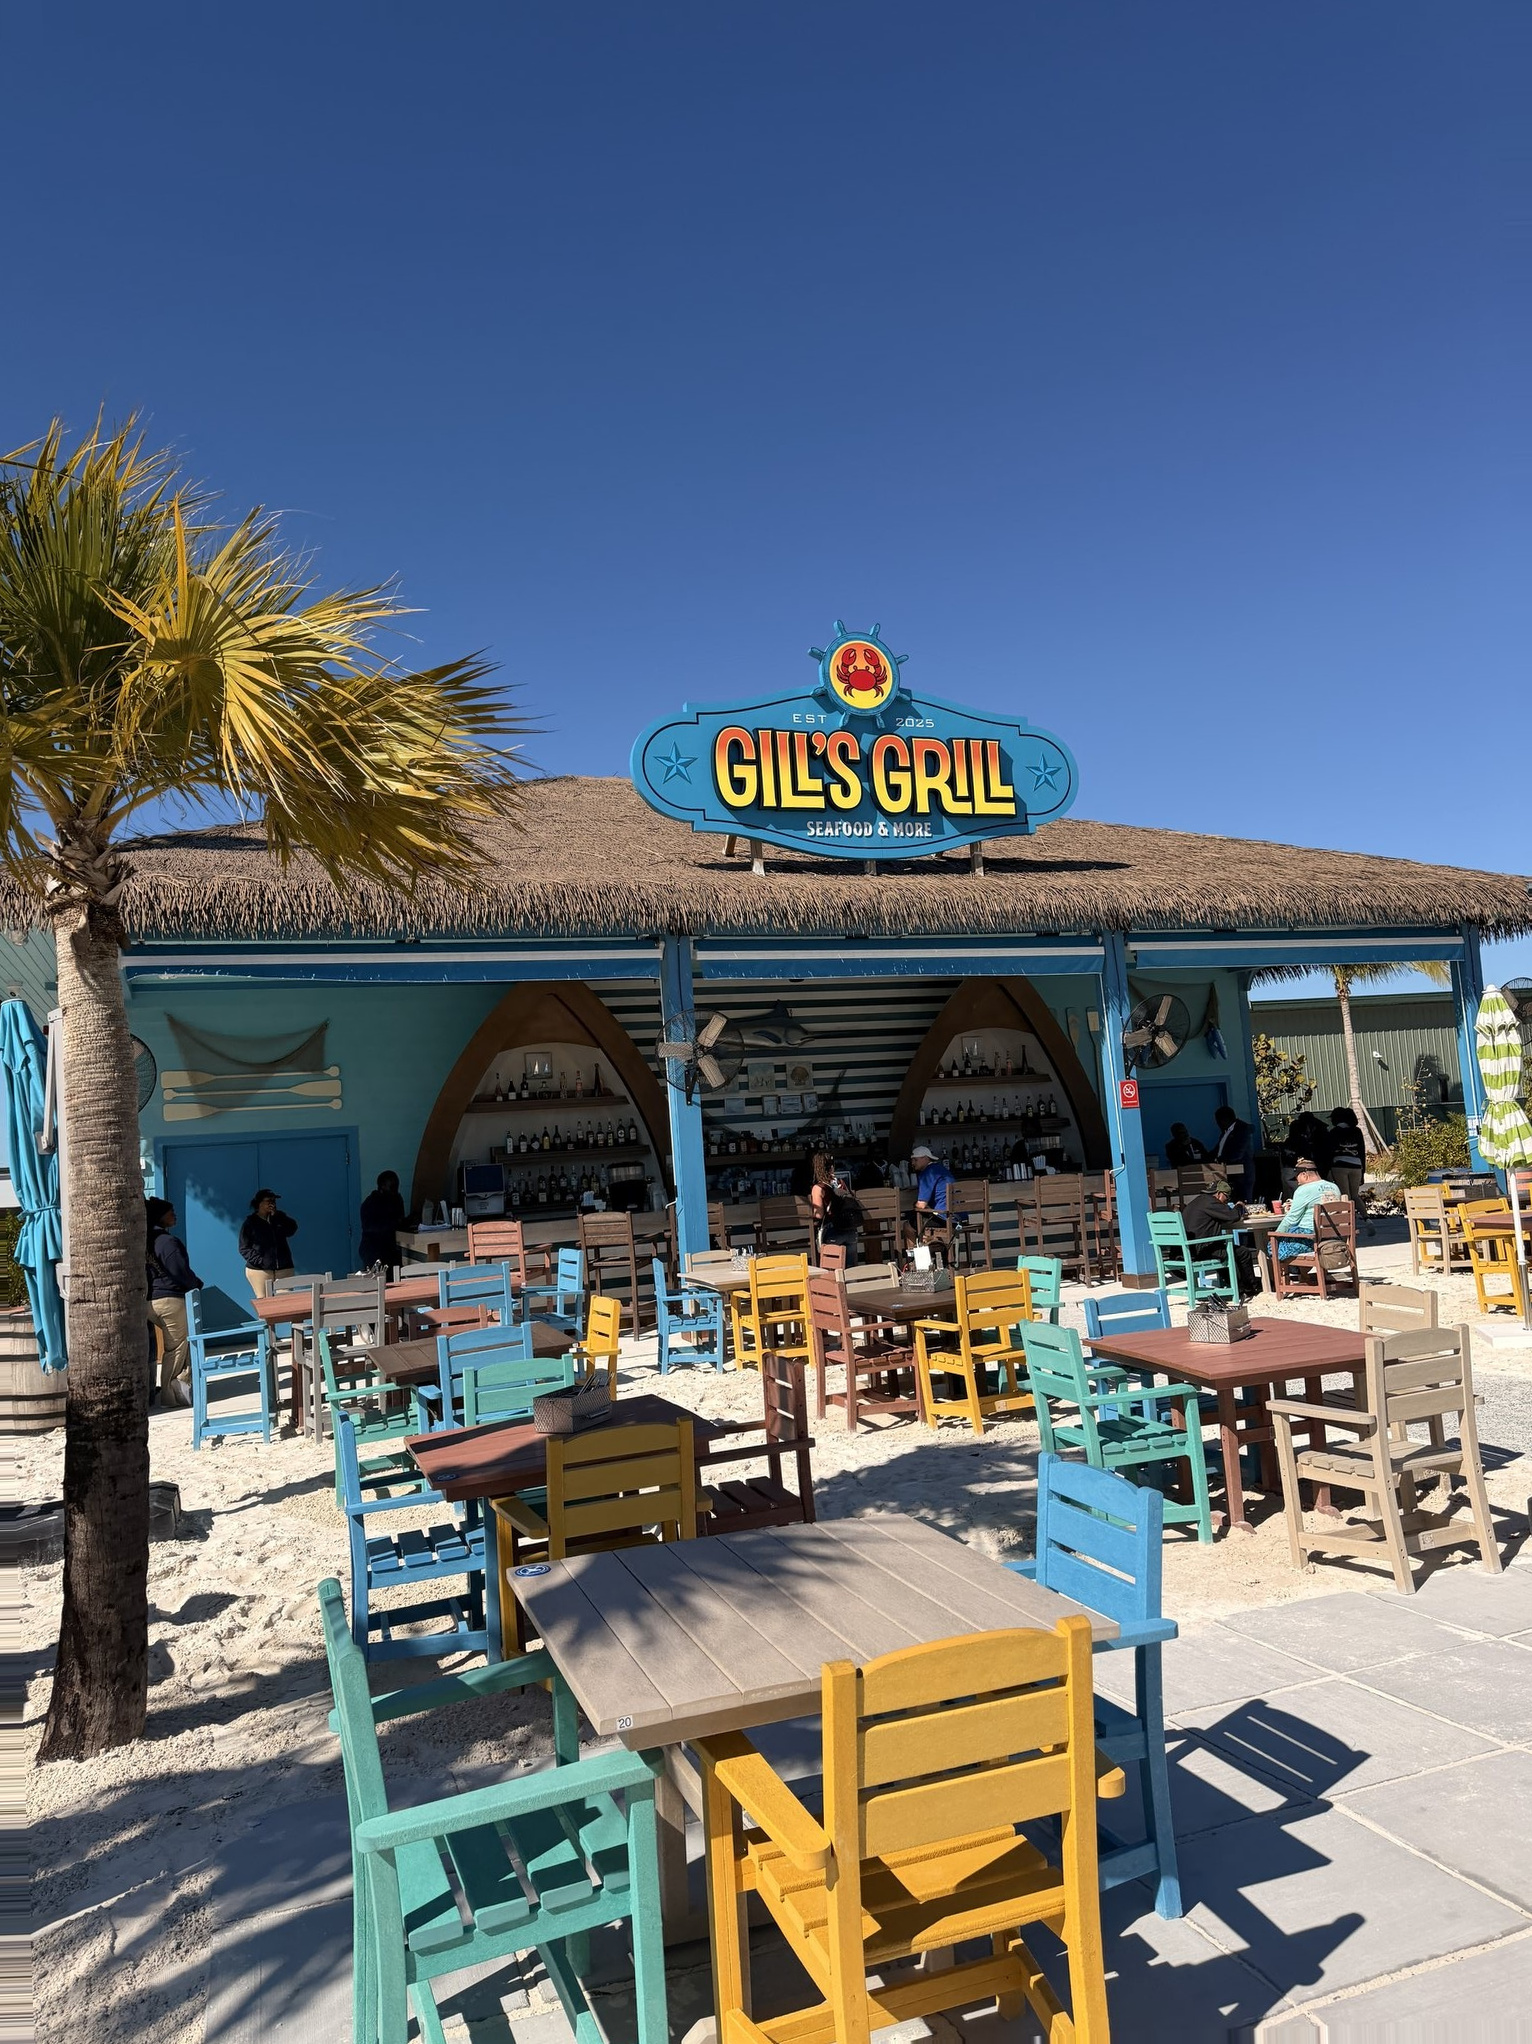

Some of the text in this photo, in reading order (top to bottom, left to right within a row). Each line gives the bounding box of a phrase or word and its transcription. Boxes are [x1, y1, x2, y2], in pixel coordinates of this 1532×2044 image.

[792, 713, 934, 728] EST 2025
[714, 725, 1016, 817] GILL'S GRILL
[806, 821, 933, 839] SEAFOOD & MORE
[618, 1716, 632, 1729] 20
